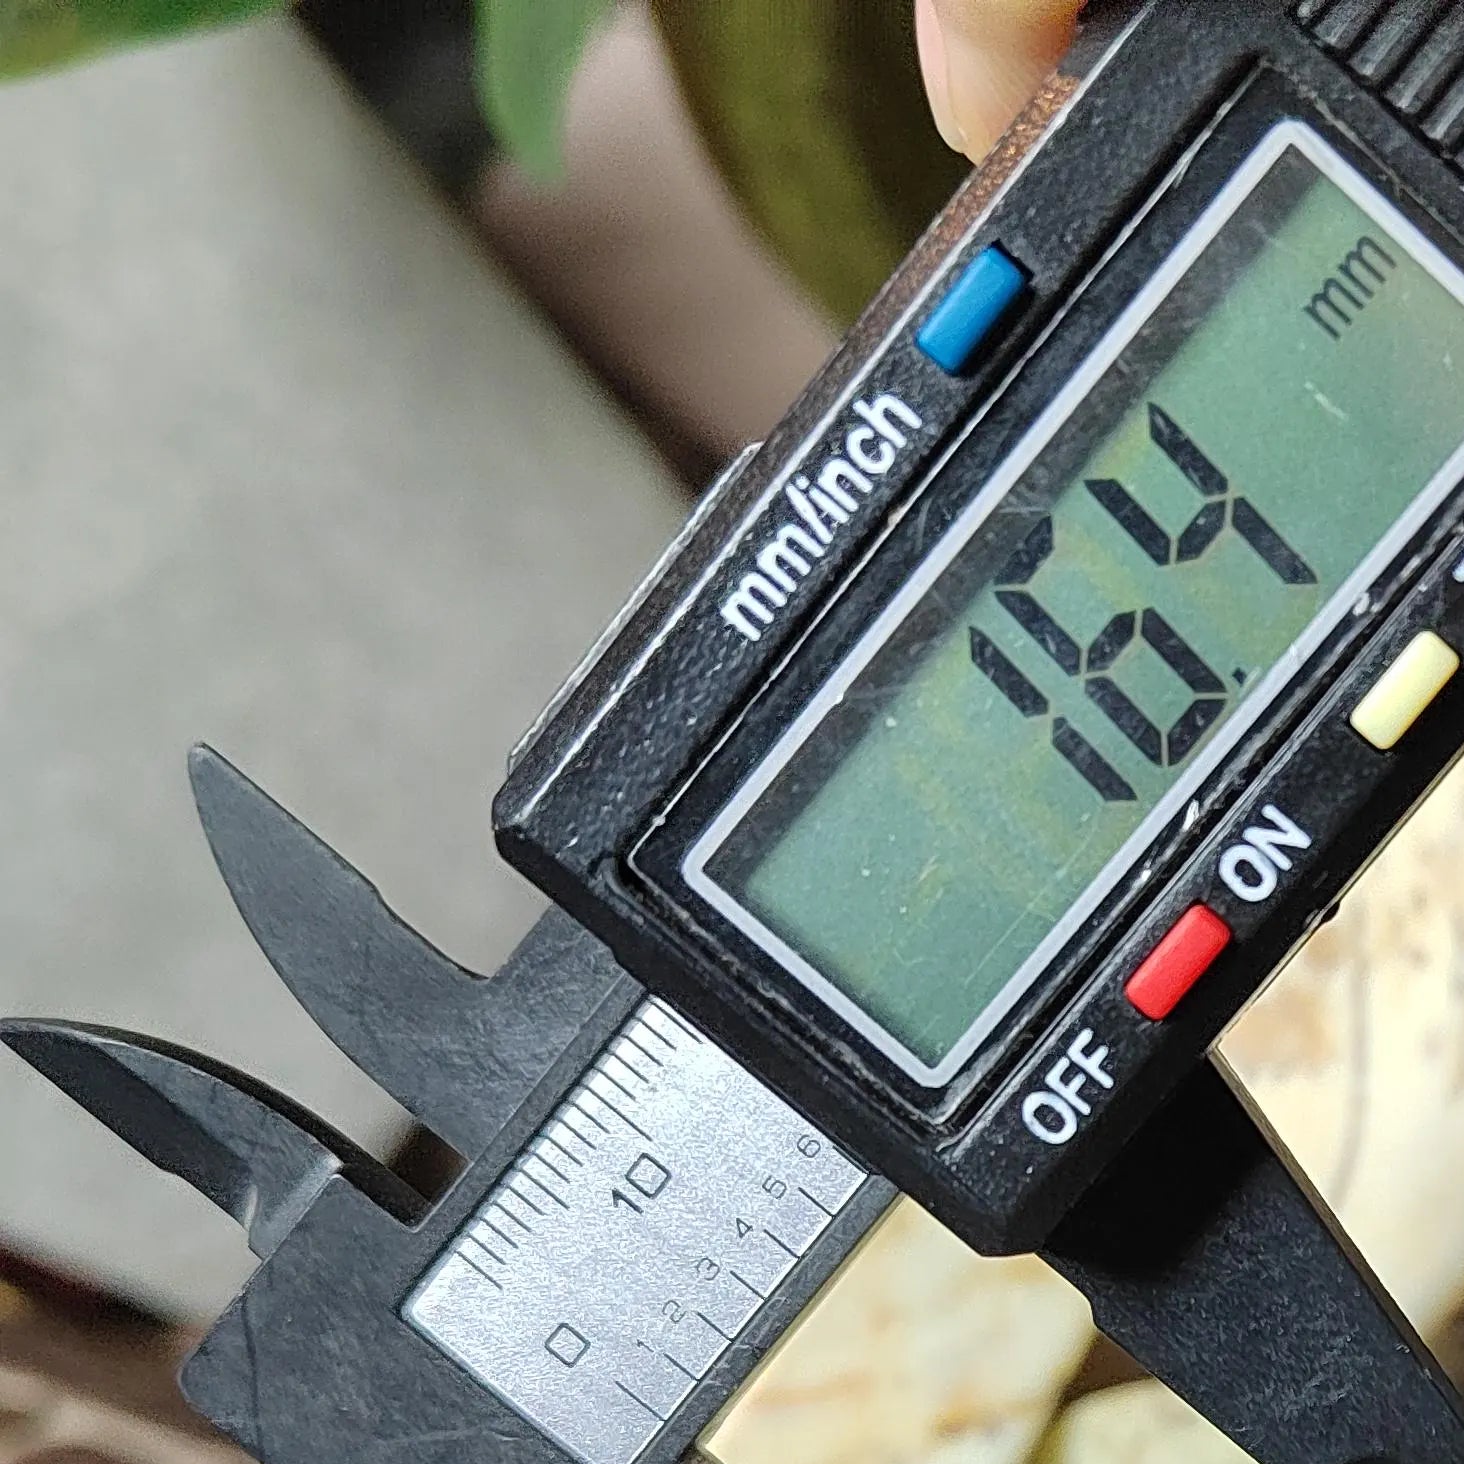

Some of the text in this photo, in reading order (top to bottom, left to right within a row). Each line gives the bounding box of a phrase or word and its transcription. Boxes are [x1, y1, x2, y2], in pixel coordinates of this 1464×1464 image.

[719, 388, 923, 643] mm/inch
[969, 234, 1399, 802] 16.4 mm
[1020, 1029, 1116, 1147] OFF
[1217, 804, 1313, 903] ON
[545, 1153, 672, 1368] 0 10
[661, 1299, 687, 1325] 2
[696, 1255, 721, 1282] 3
[735, 1216, 754, 1239] 4
[762, 1175, 788, 1200] 5
[796, 1133, 822, 1158] 6
